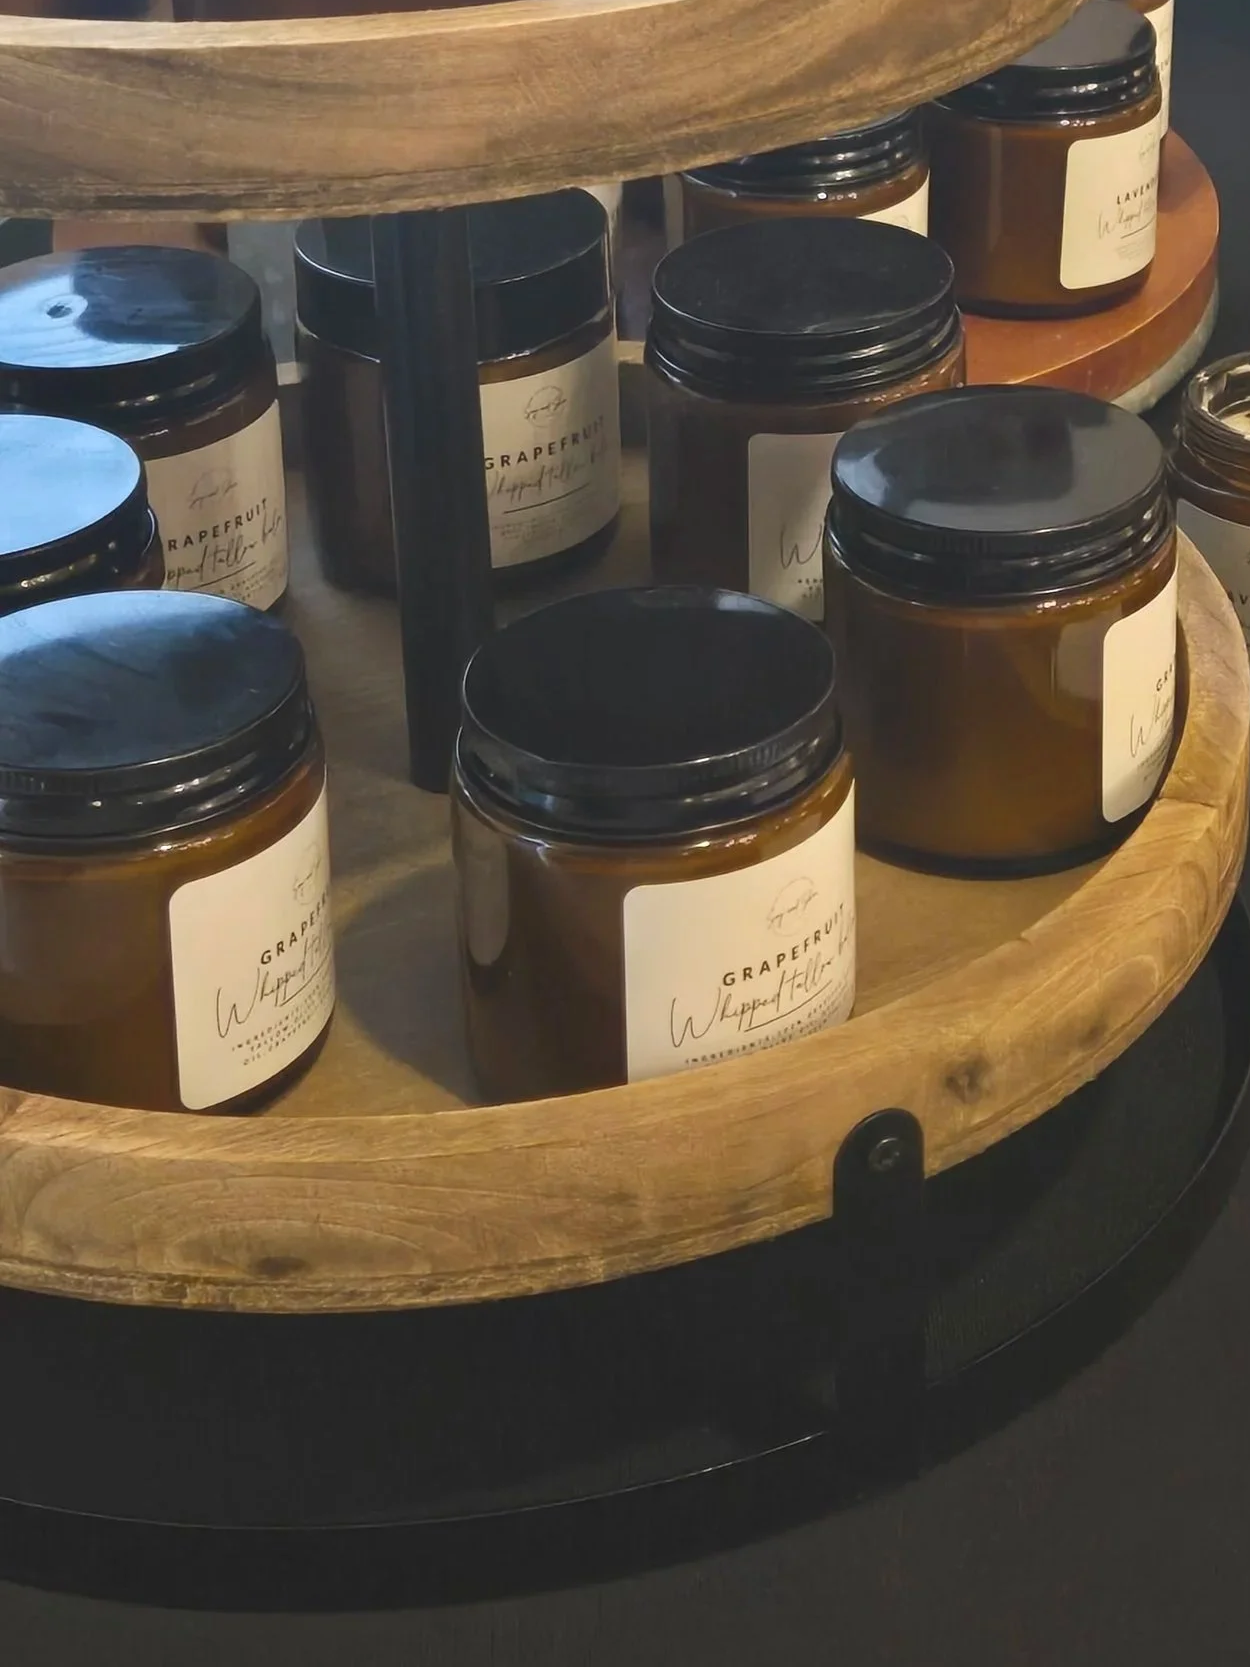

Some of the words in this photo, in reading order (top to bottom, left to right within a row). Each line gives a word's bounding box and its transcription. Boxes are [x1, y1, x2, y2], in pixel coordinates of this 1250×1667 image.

[167, 498, 266, 552] RAPEFRUIT
[722, 902, 844, 987] GRAPEFRUIT
[670, 969, 786, 1049] Whipped
